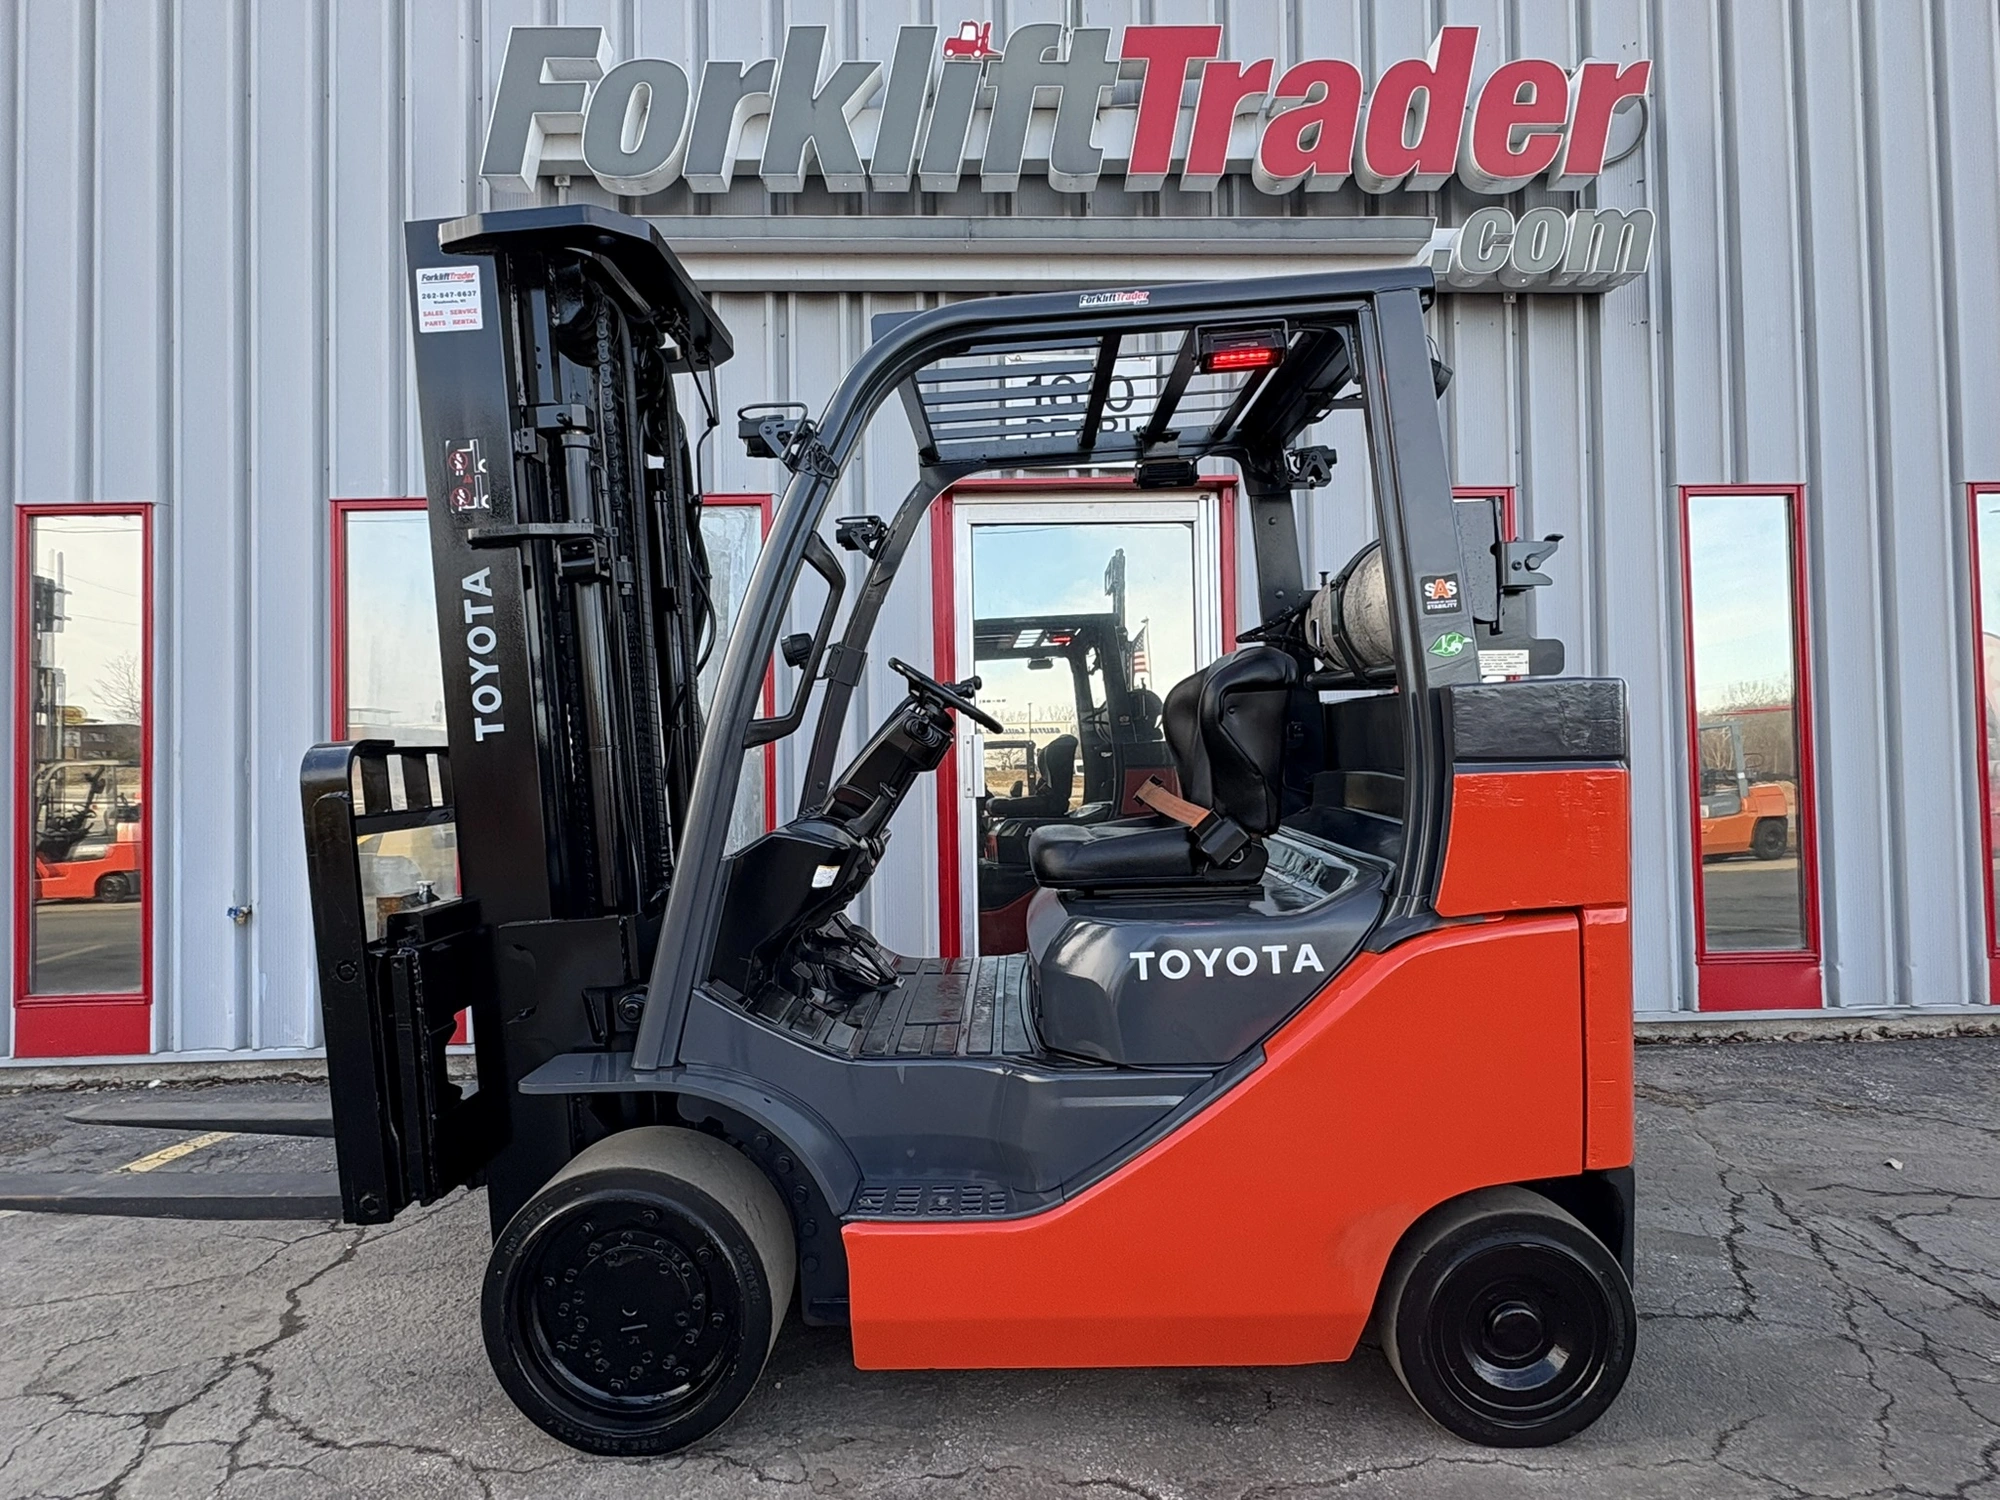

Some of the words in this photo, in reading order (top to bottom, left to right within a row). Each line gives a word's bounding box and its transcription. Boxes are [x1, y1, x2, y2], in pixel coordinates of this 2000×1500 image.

[480, 21, 1652, 180] ForkliftTrader
[1431, 206, 1657, 275] .com
[421, 270, 476, 283] ForkliftTrader
[1080, 291, 1149, 304] ForkliftTrader
[423, 309, 444, 317] SALES
[449, 308, 478, 316] SERVICE
[424, 319, 446, 327] PARTS
[452, 318, 478, 326] RENTAL
[1424, 578, 1458, 600] SAS
[1426, 602, 1458, 610] STABILITY
[461, 566, 506, 743] TOYOTA
[1129, 943, 1325, 981] TOYOTA
